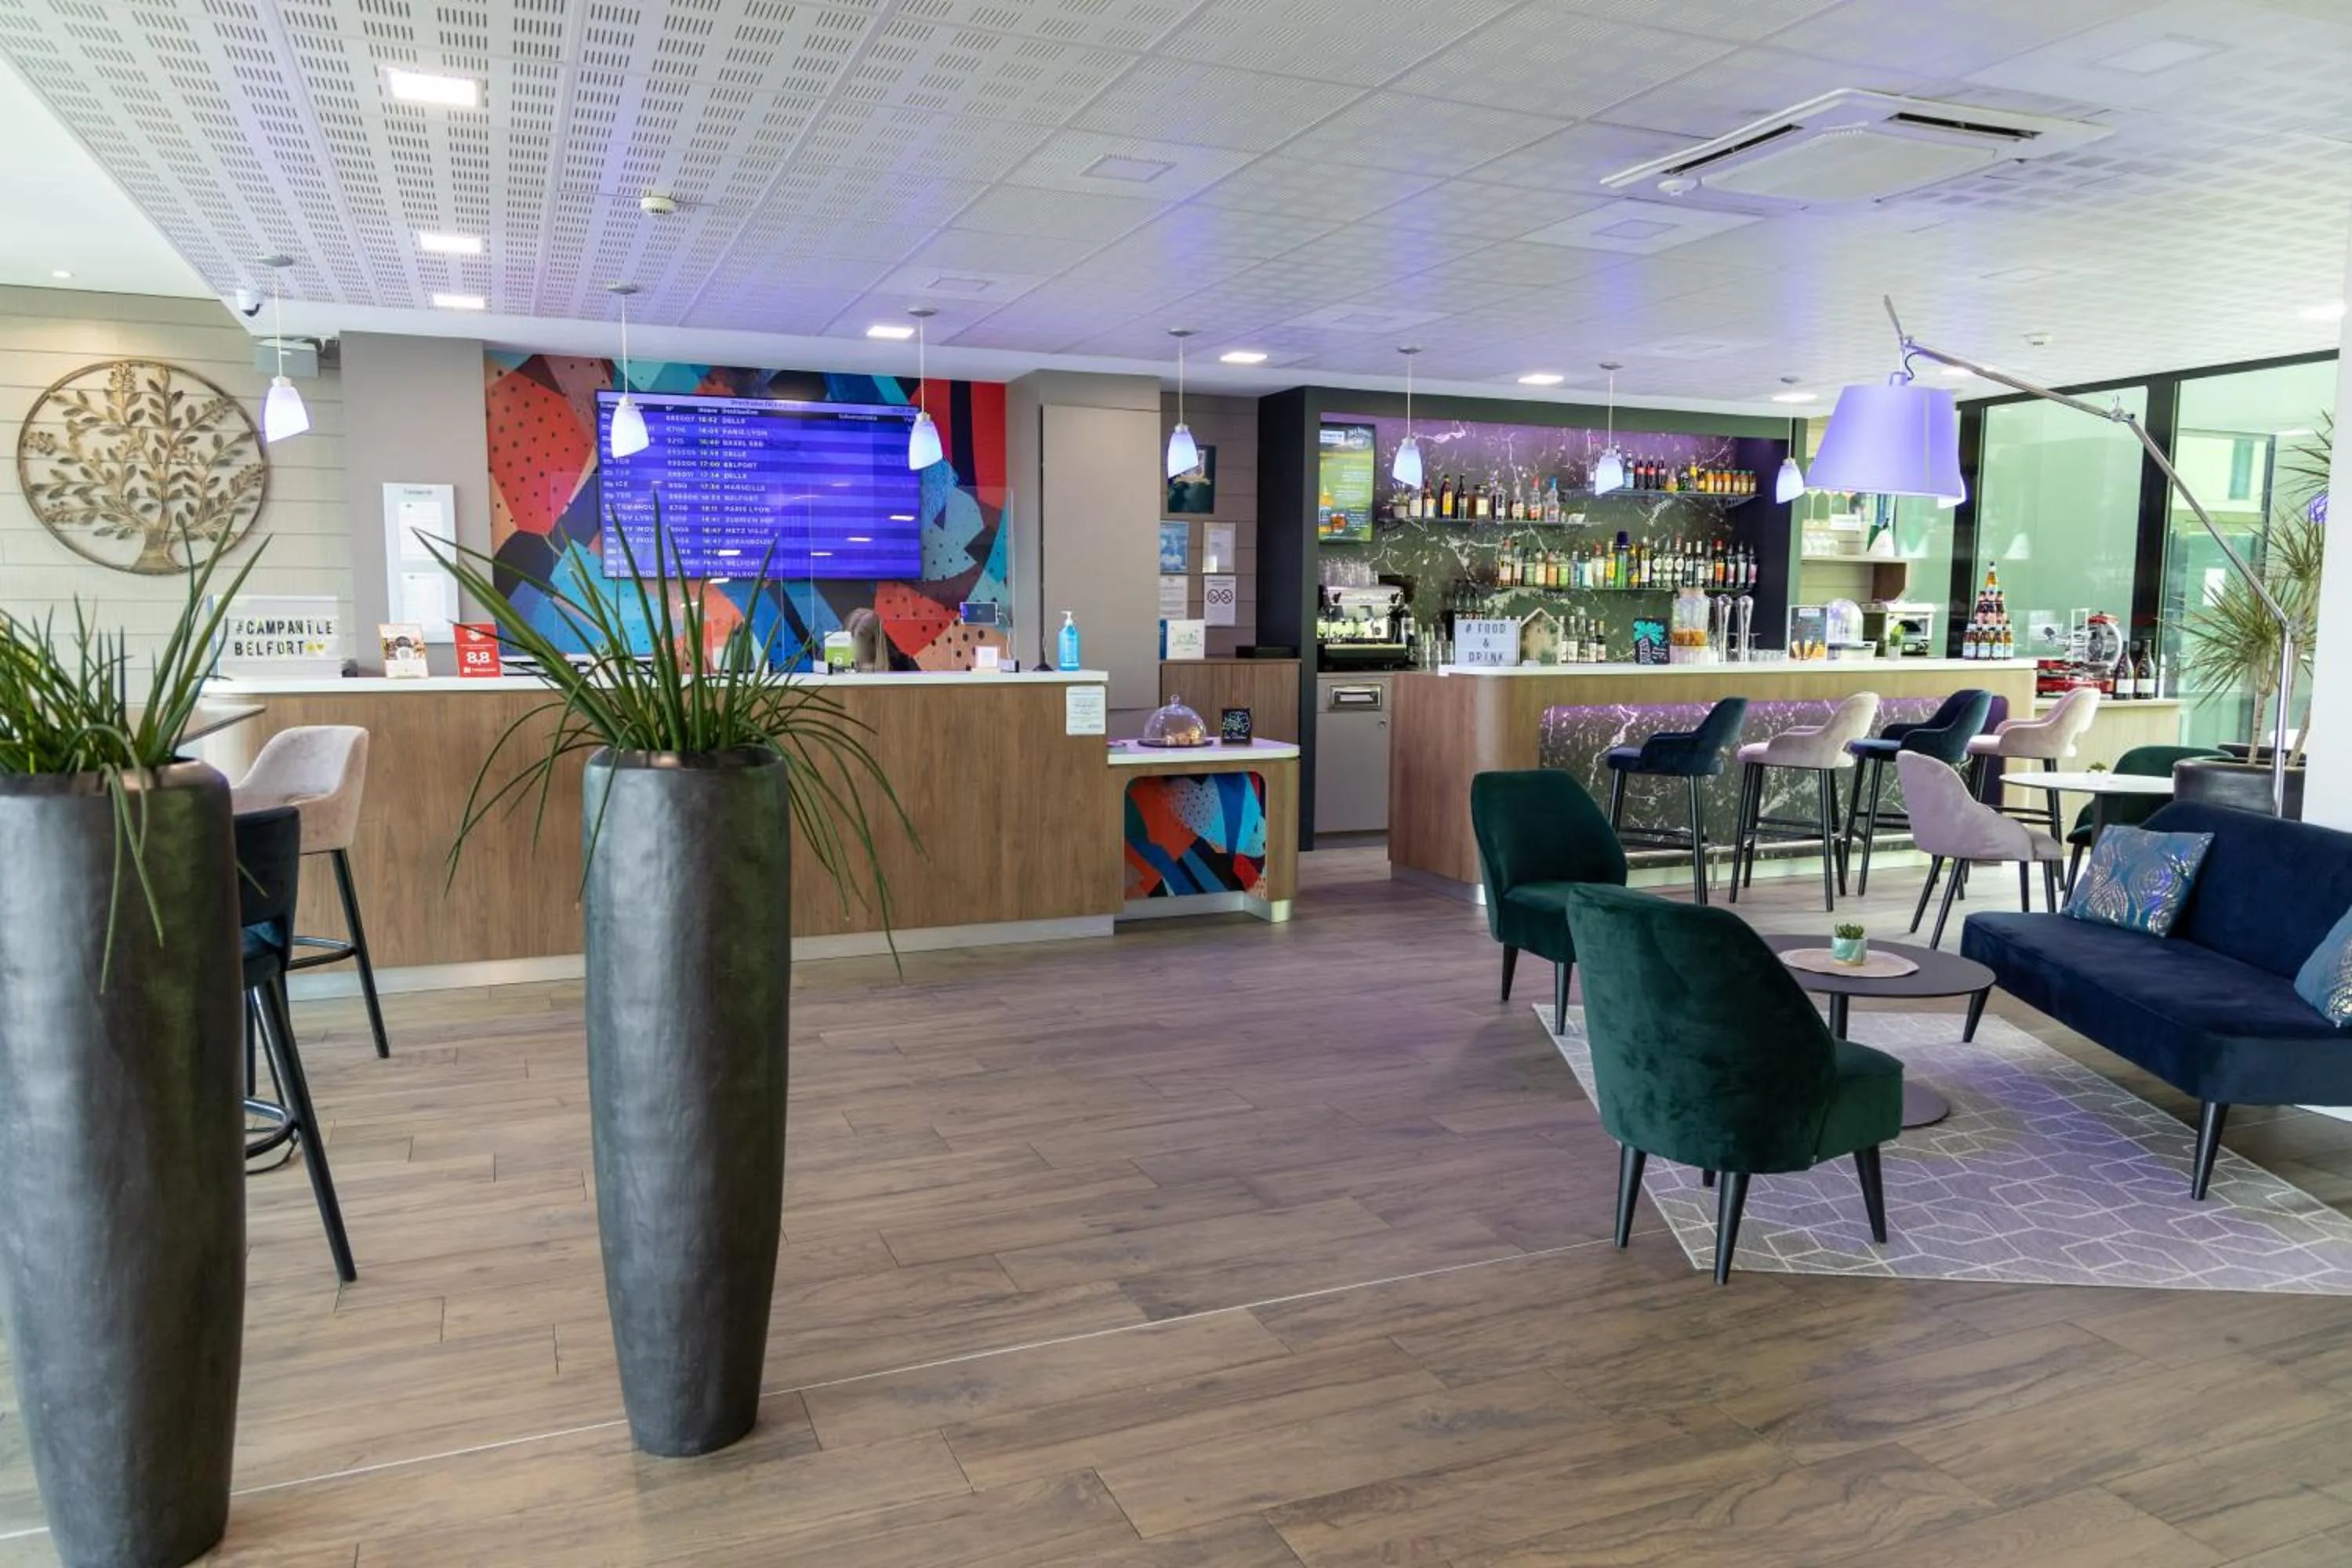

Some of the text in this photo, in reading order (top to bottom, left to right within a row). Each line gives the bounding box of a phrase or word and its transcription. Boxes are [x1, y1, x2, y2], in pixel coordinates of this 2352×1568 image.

[1478, 623, 1506, 633] FOOD
[235, 641, 303, 656] BELFORT
[1468, 652, 1503, 662] DRINK
